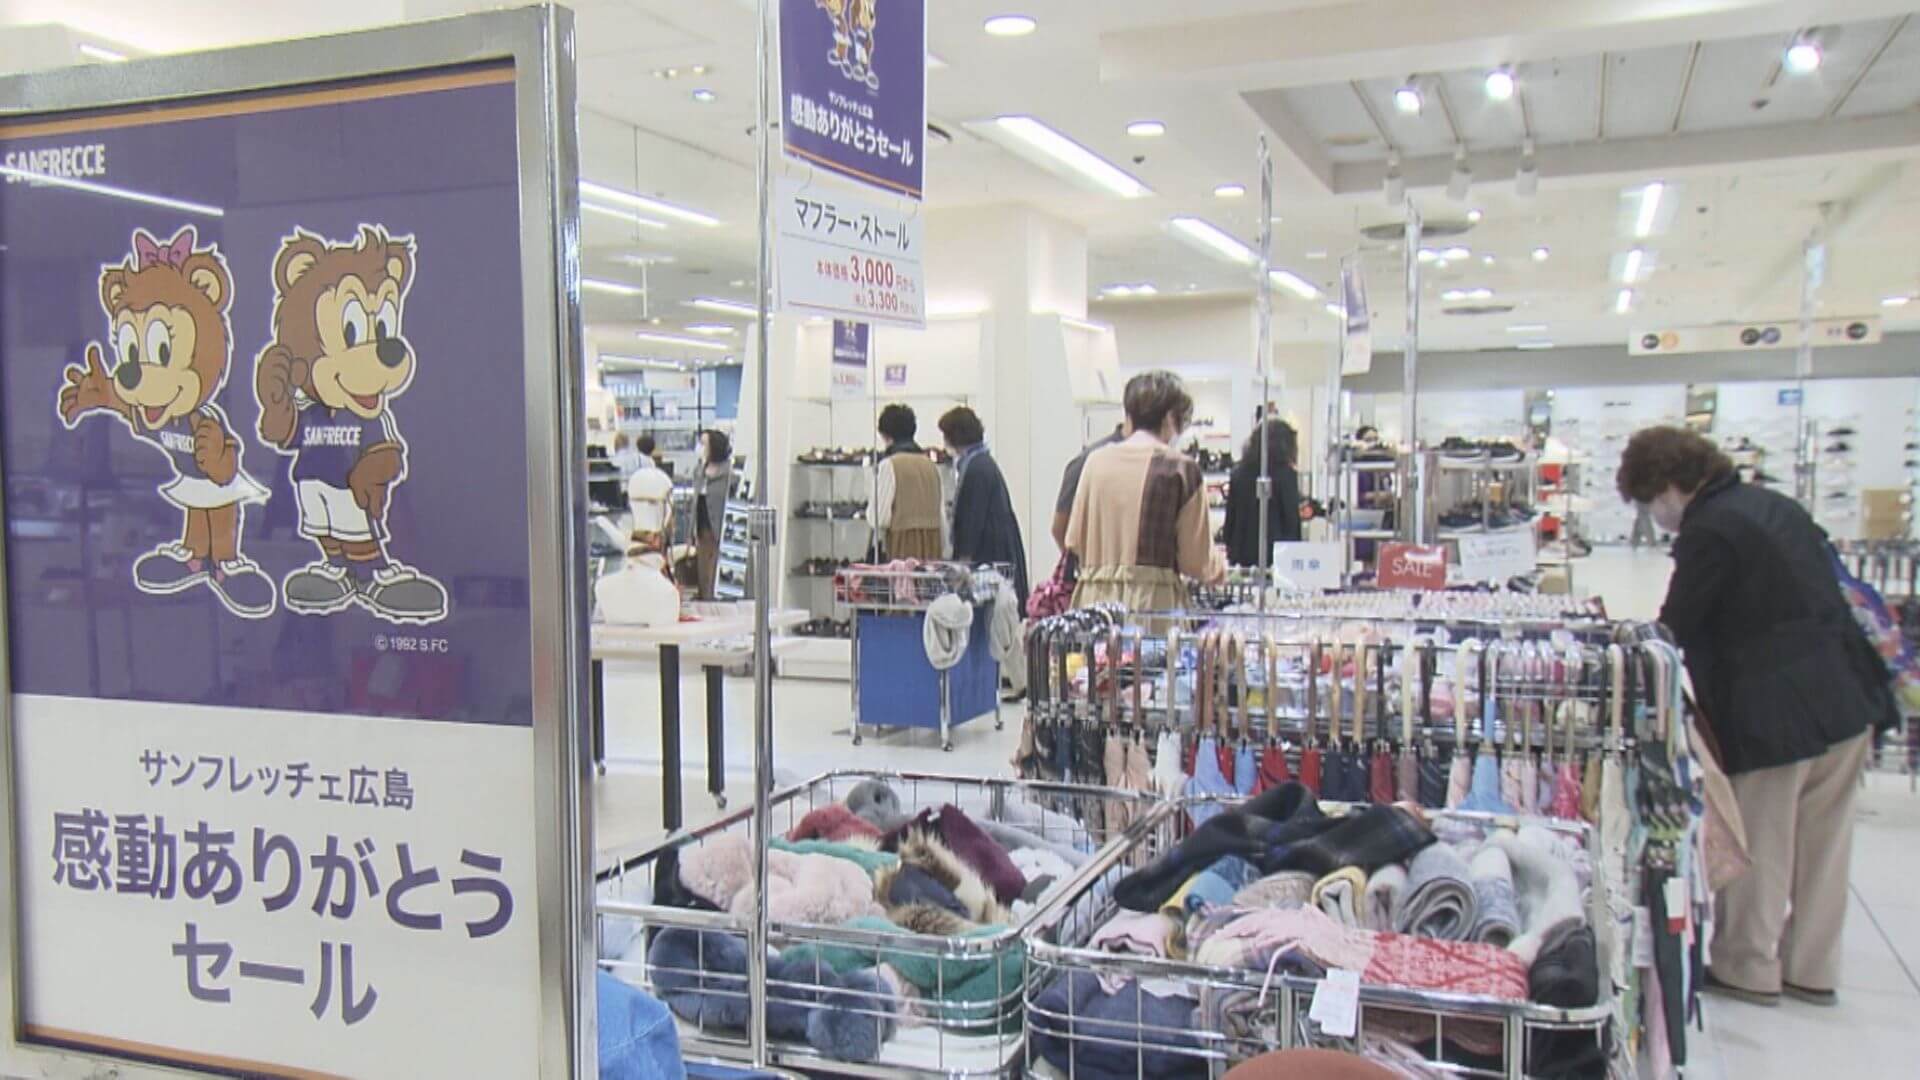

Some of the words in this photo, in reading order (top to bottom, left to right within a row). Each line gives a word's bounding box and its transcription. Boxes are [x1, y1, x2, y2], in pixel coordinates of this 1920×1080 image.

[790, 93, 914, 167] 感動ありがとうセール
[5, 144, 106, 184] SANFRECCE
[794, 197, 910, 251] マフラー・ストール
[303, 426, 362, 446] SANFRECCE
[1391, 557, 1433, 578] SALE
[139, 749, 415, 811] サンフレッチェ広島
[51, 807, 514, 938] 感動ありがとう
[172, 922, 378, 1026] セール
